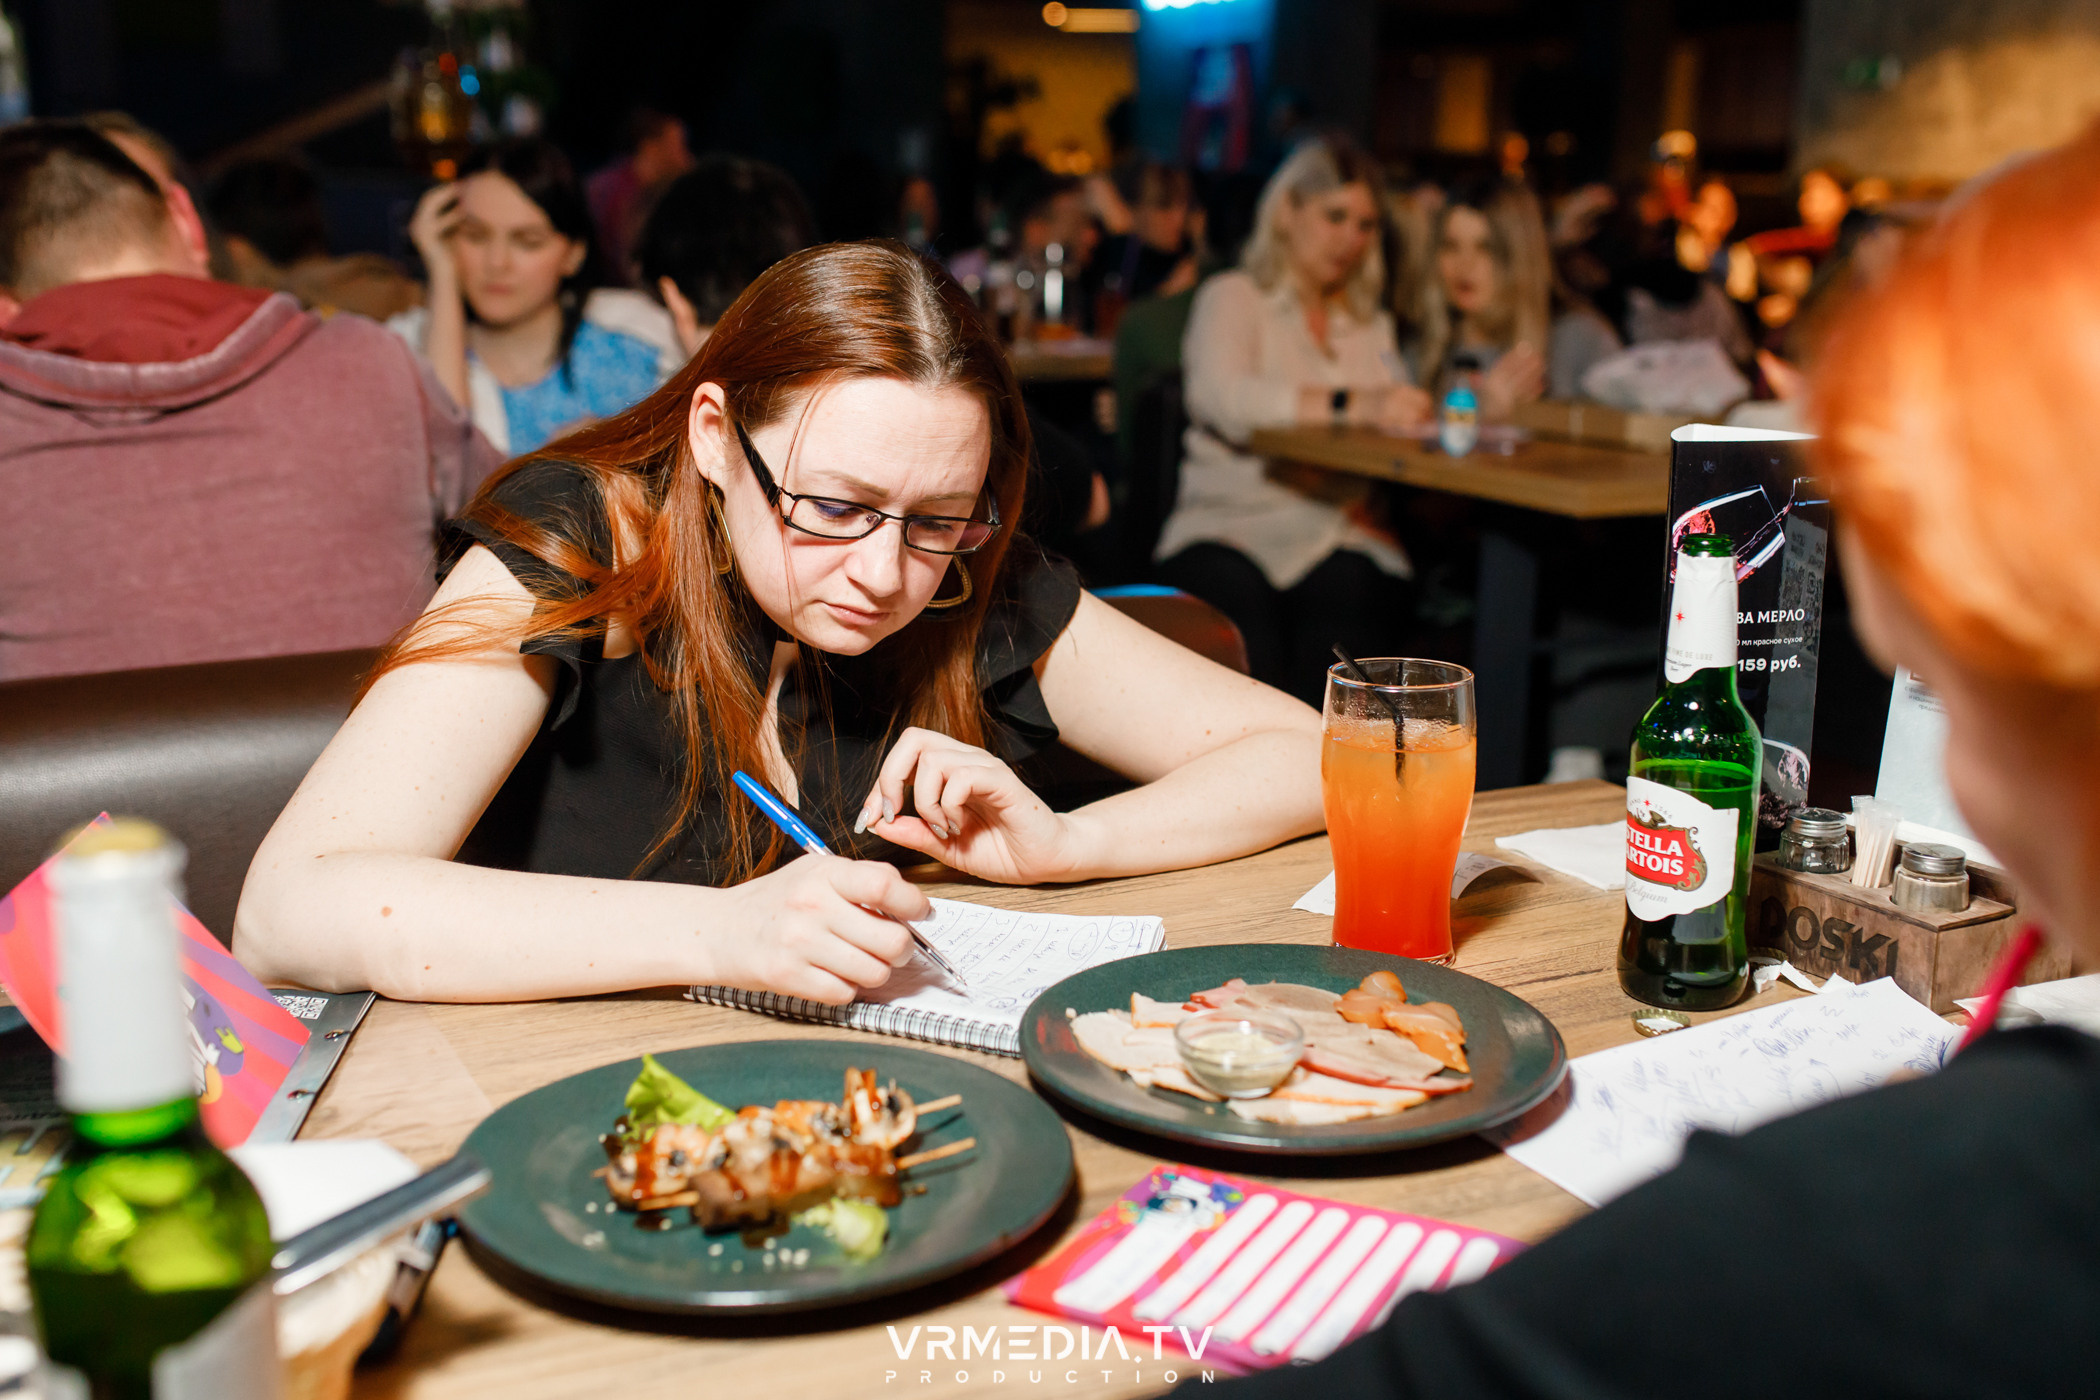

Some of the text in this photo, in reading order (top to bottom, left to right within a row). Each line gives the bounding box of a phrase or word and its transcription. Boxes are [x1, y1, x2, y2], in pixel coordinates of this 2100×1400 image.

[1757, 608, 1805, 623] МЕРЛО
[1753, 637, 1782, 647] красное
[1783, 636, 1803, 645] сухое
[1737, 654, 1801, 673] 159 руб.
[1760, 896, 1899, 978] DOSKI
